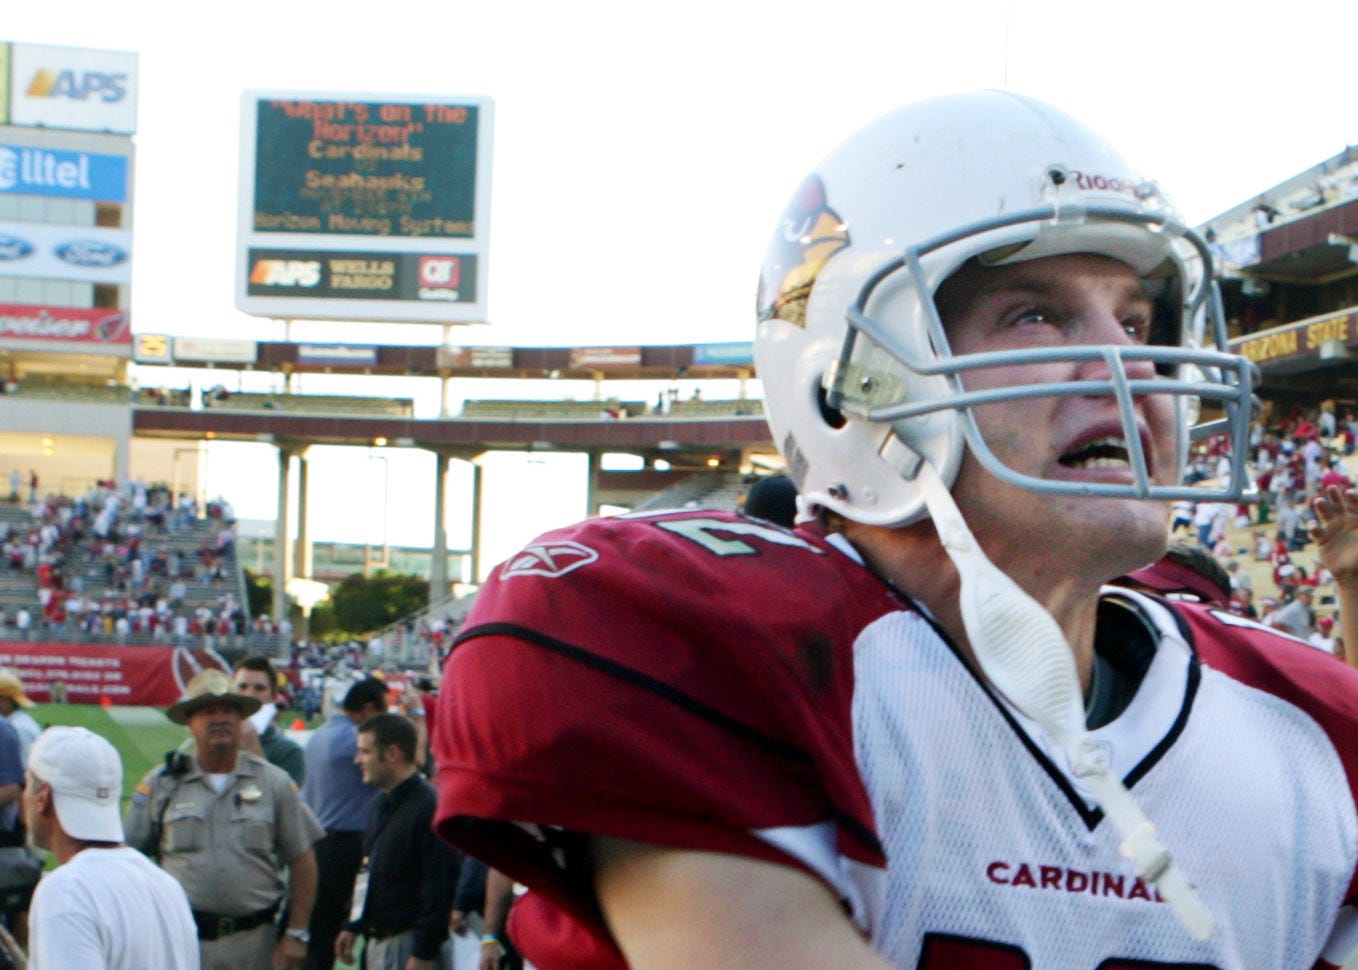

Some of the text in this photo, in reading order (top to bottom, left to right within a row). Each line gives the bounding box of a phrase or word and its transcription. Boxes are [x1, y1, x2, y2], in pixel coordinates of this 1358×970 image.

[52, 68, 128, 103] APS
[307, 140, 424, 163] Cardinals
[329, 259, 395, 275] WELLS
[330, 273, 393, 290] FARGO
[986, 860, 1165, 903] CARDINA
